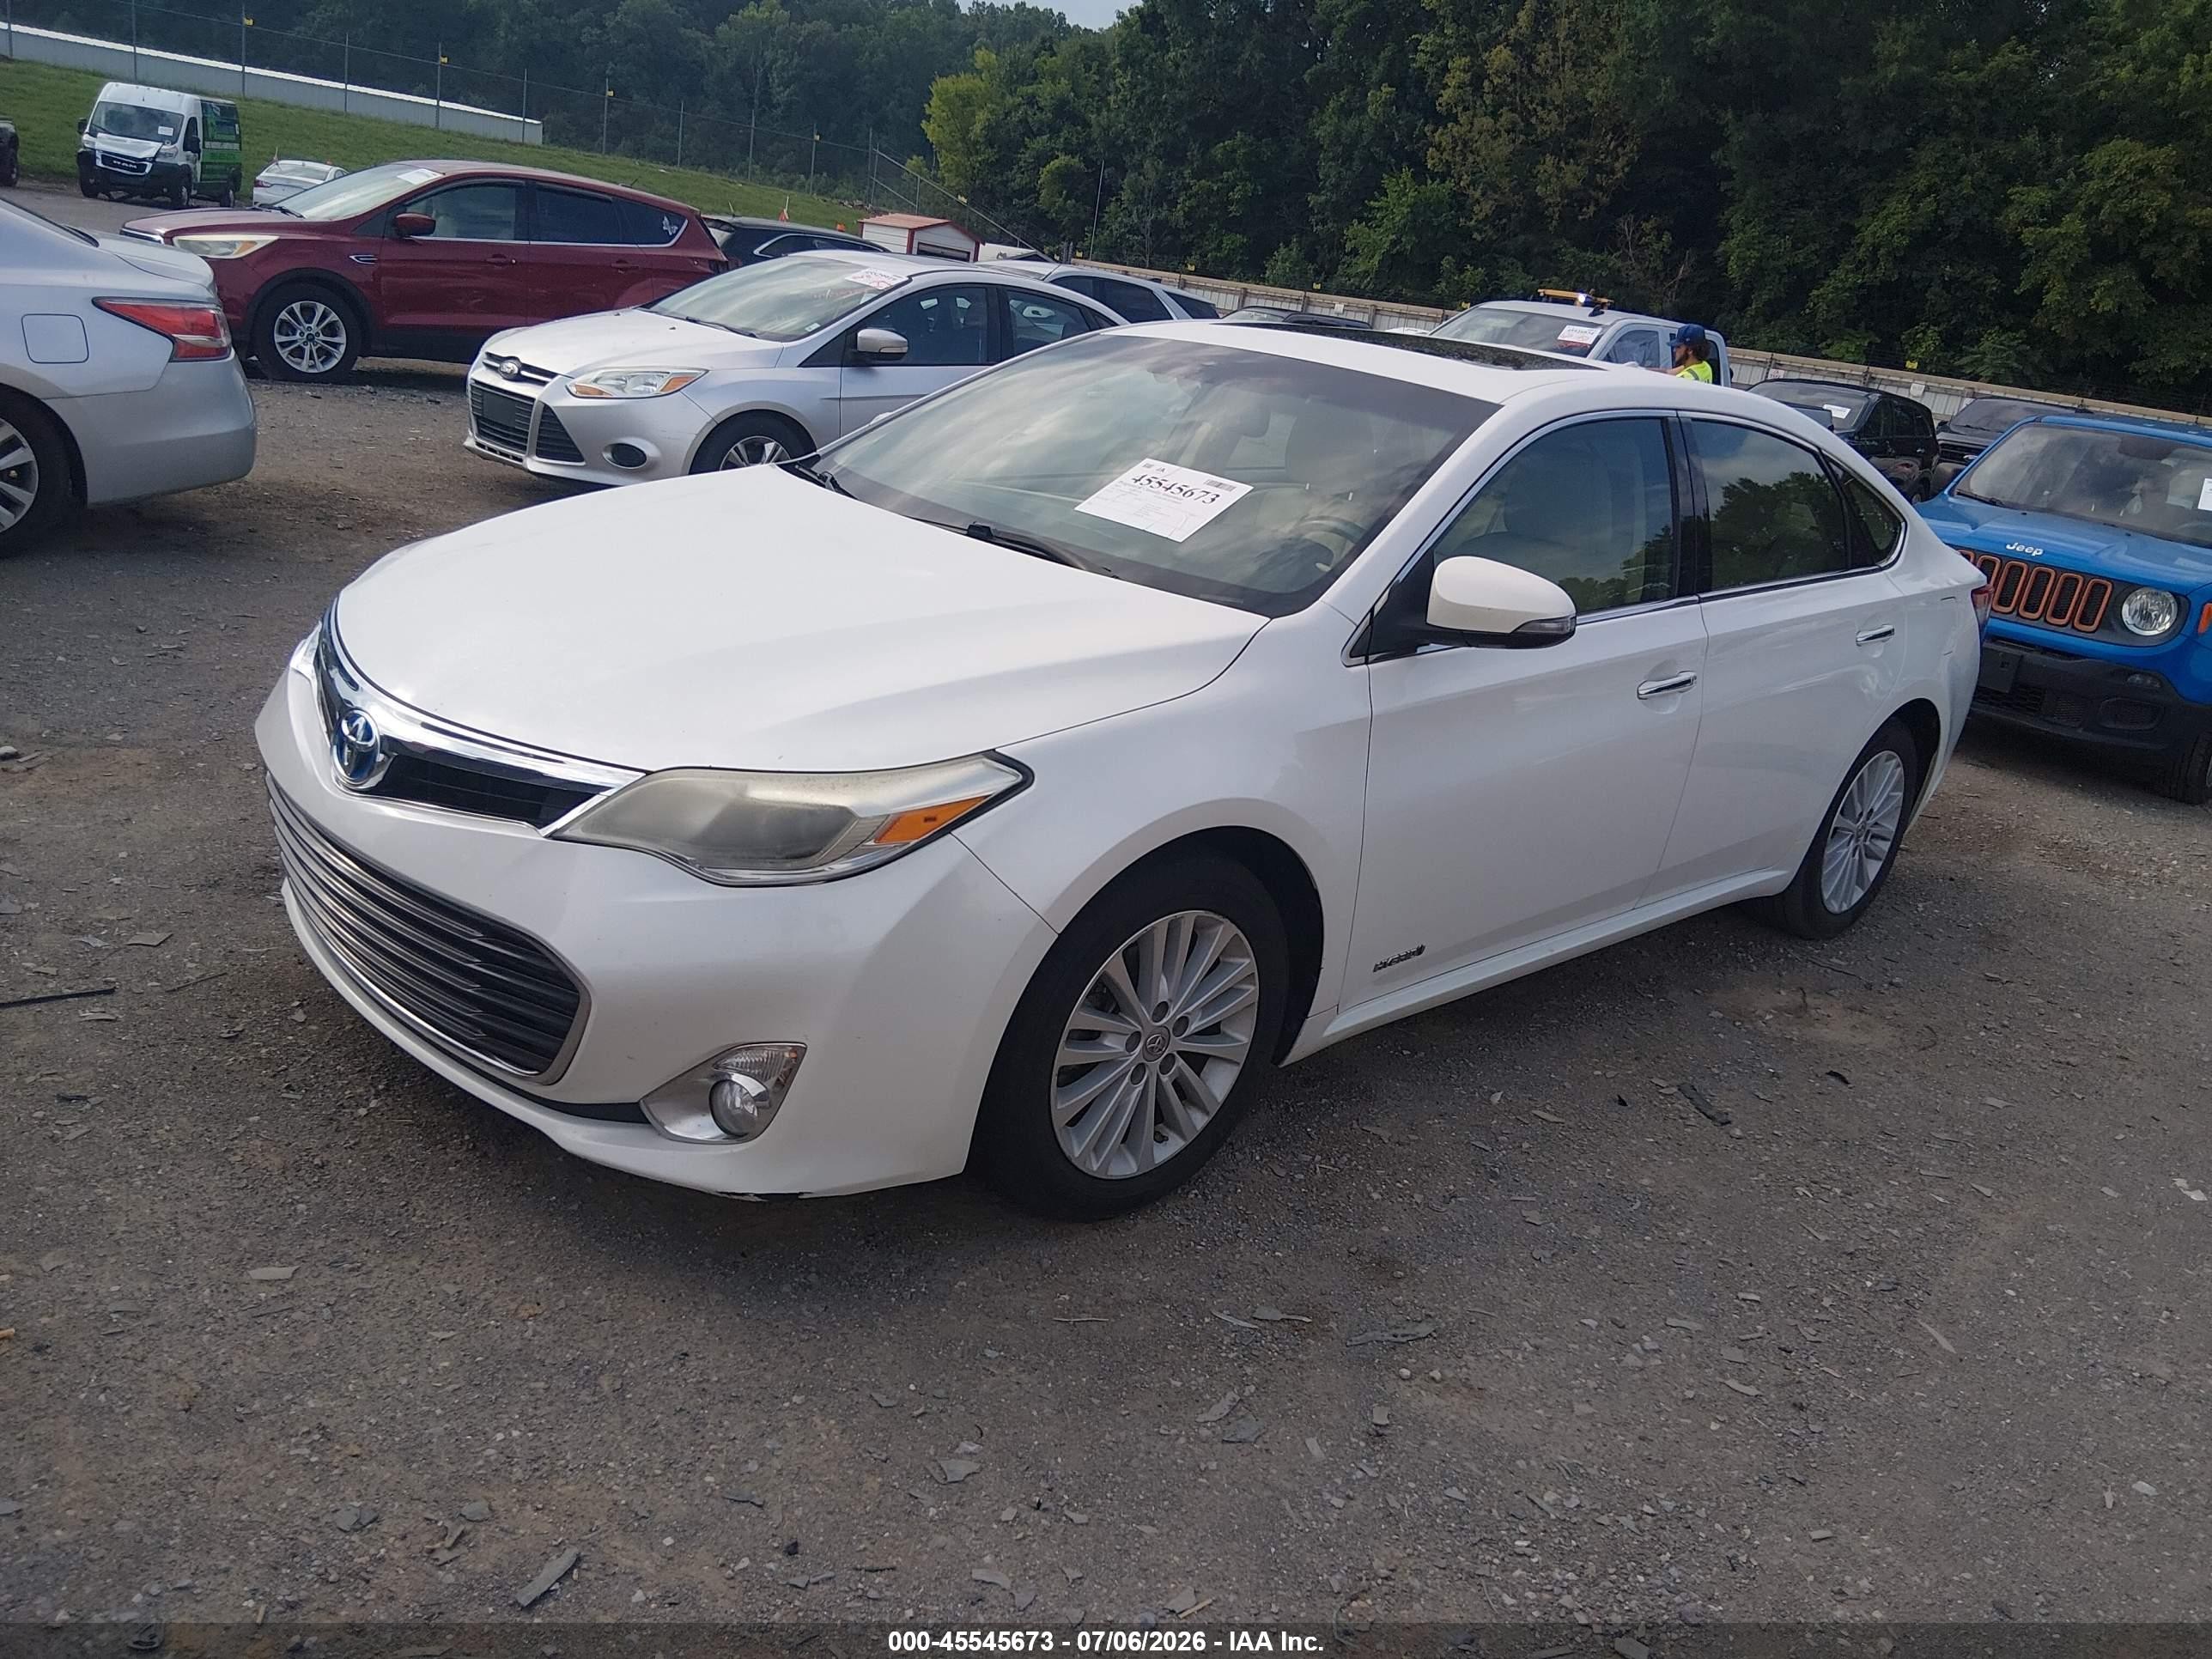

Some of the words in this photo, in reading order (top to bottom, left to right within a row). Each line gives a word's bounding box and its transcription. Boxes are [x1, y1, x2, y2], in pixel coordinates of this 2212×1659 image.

[112, 160, 137, 169] RAM
[1132, 474, 1220, 504] 45545673
[2005, 542, 2044, 556] Jeep
